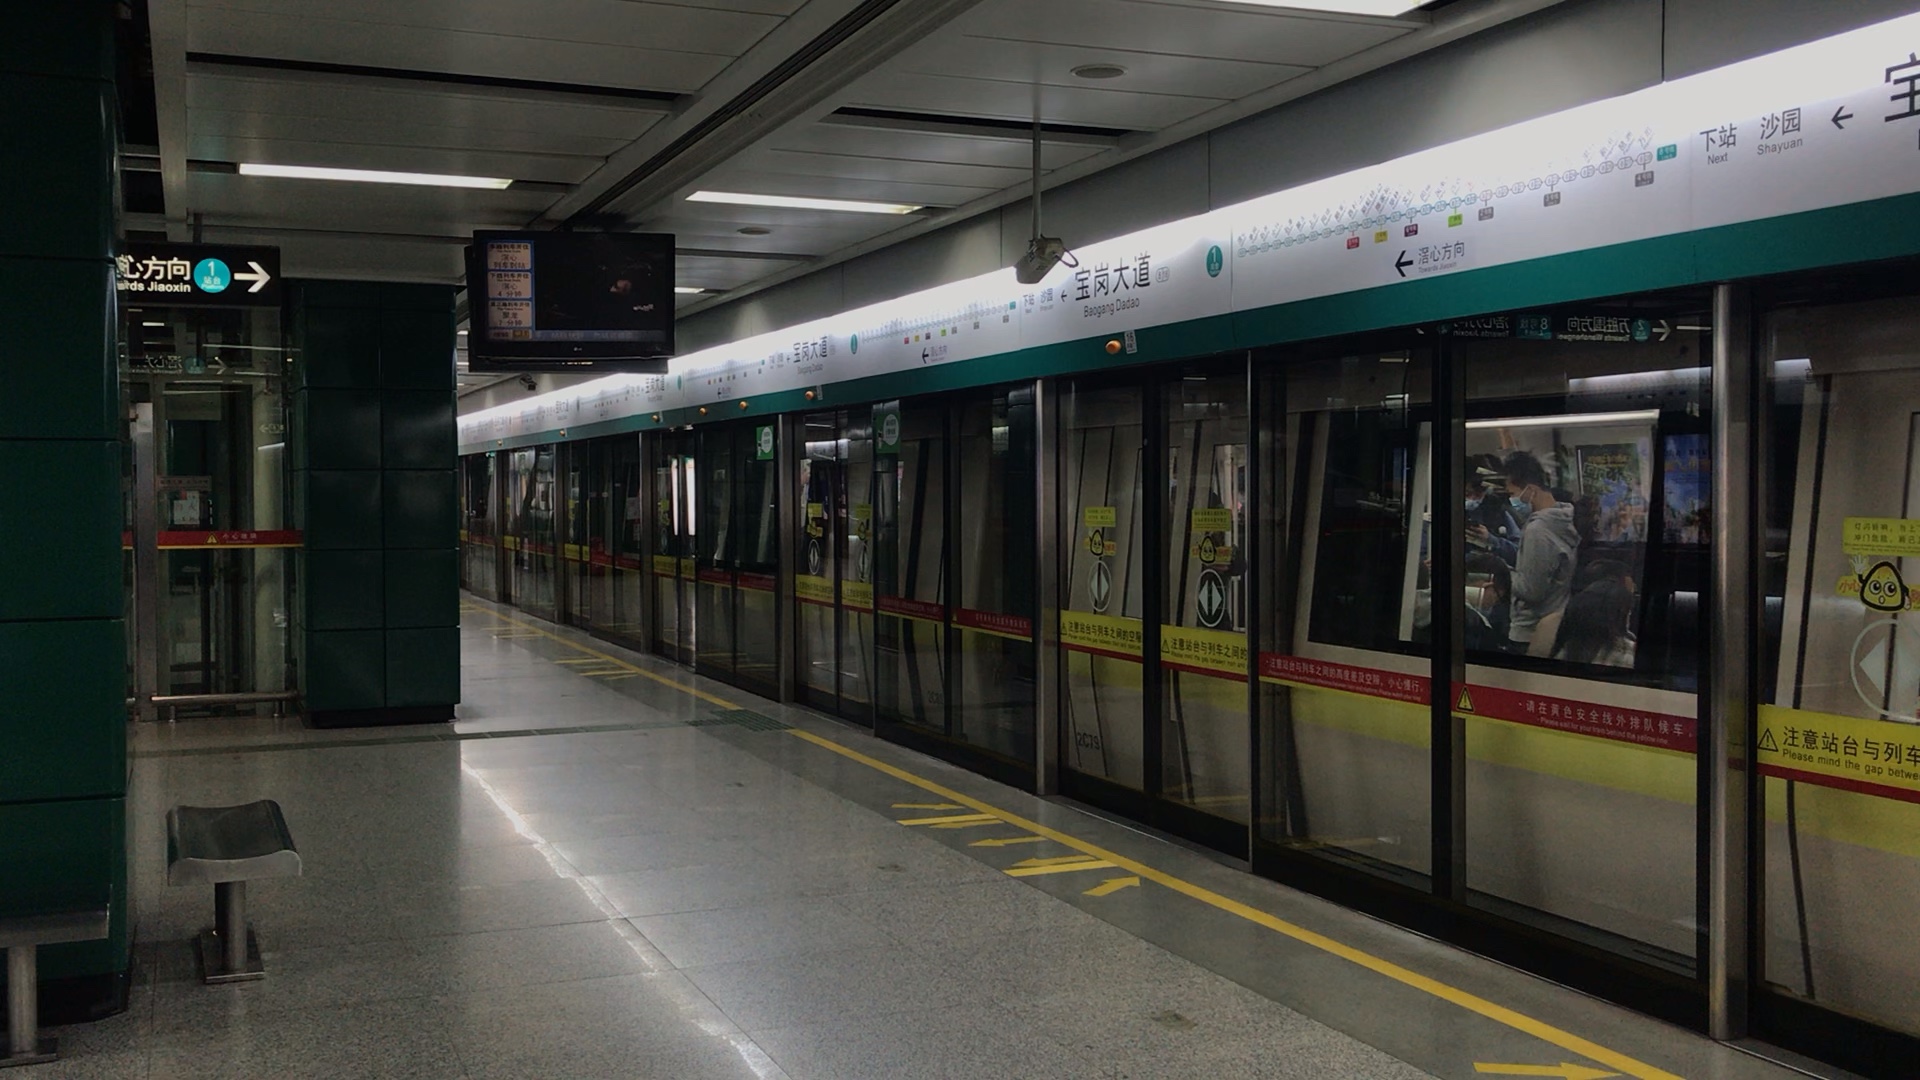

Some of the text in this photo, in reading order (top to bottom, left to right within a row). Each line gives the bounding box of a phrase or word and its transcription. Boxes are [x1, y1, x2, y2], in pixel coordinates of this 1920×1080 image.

[1760, 107, 1801, 140] 沙园
[1699, 123, 1737, 152] 下站
[1757, 138, 1803, 156] Shayuan
[1707, 152, 1728, 165] Next
[208, 261, 214, 276] 1
[1075, 251, 1151, 301] 宝岗大道
[147, 281, 192, 292] Jiaoxin
[1084, 297, 1140, 318] Baogang Dadao
[1783, 726, 1920, 767] 注意站台与列车
[1783, 748, 1814, 763] Please
[1817, 756, 1841, 767] mind
[1844, 759, 1861, 771] the
[1863, 764, 1884, 776] gap
